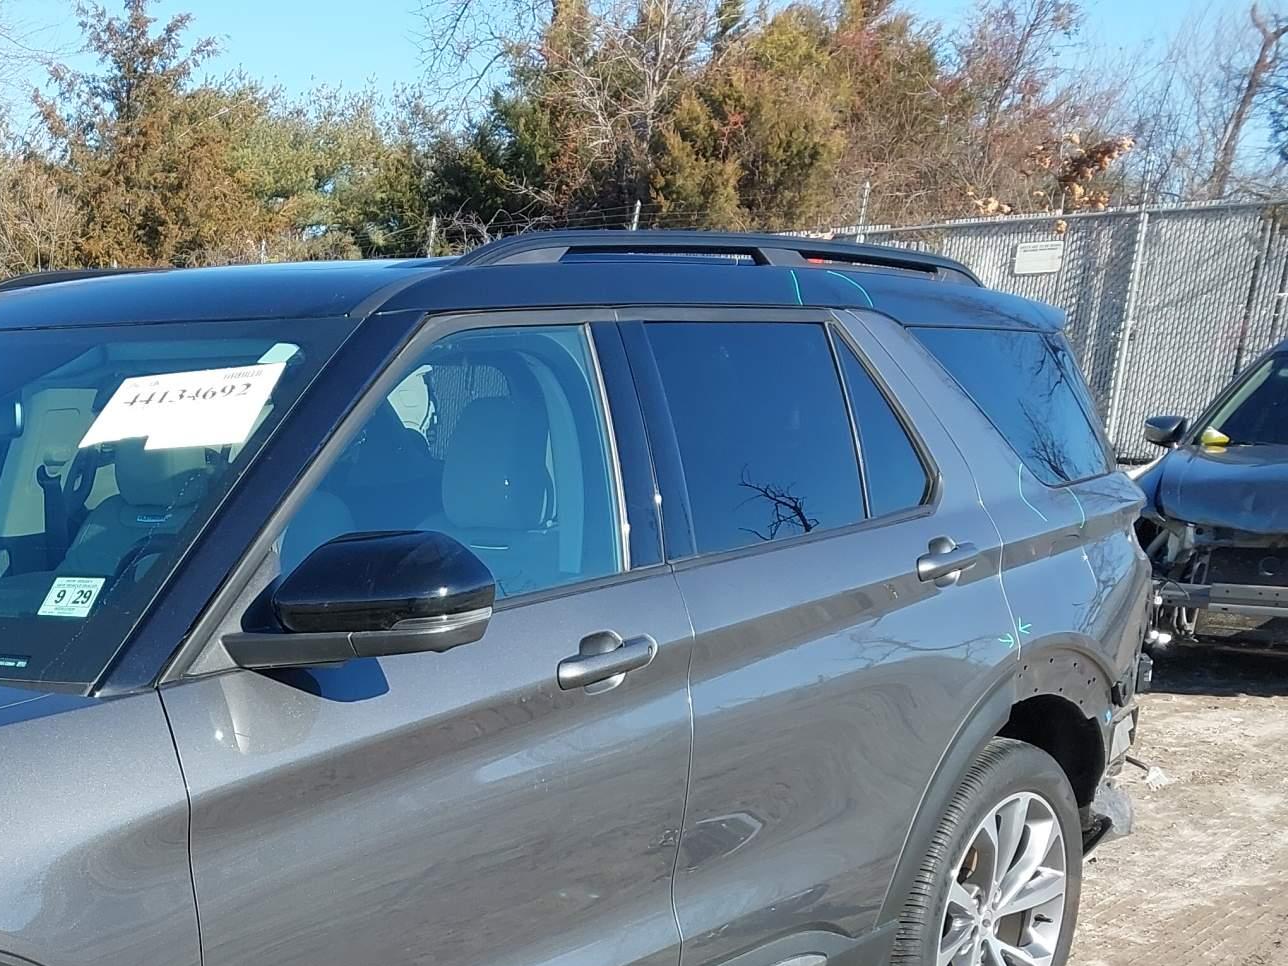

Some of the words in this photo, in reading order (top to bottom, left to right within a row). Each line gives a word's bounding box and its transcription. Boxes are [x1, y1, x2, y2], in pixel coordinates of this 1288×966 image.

[123, 382, 253, 407] 44134692
[54, 589, 66, 604] 9
[72, 589, 93, 605] 29
